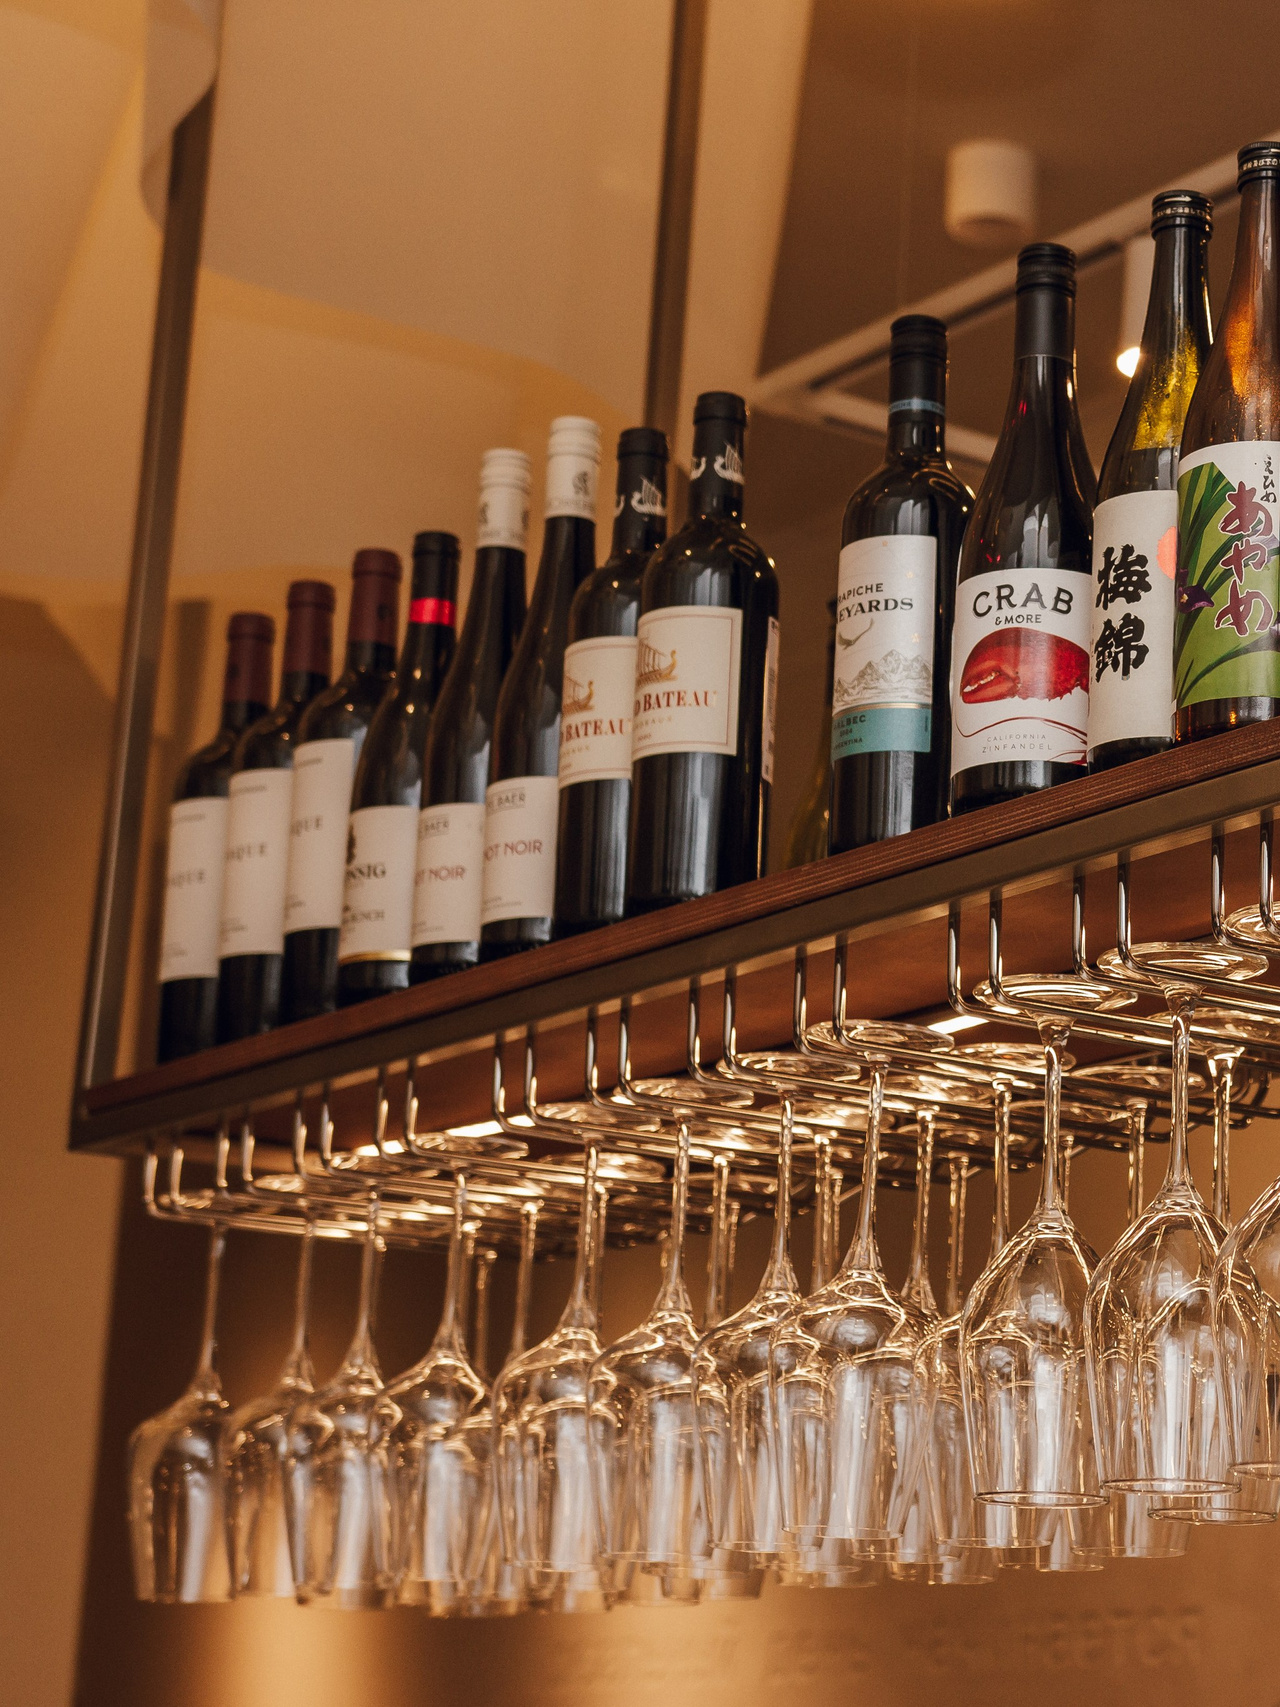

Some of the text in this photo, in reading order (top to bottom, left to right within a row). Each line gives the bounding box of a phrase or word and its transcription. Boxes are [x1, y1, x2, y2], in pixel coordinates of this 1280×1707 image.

[1214, 480, 1275, 638] あやめ
[972, 582, 1074, 618] CRAB
[994, 614, 1042, 626] & MORE
[1094, 543, 1153, 683] 梅錦
[643, 690, 716, 713] BATEAU
[565, 718, 632, 742] BATEAU
[986, 733, 1047, 743] CALIFORNIA
[982, 743, 1053, 754] ZINFANDEL
[503, 839, 543, 857] NOIR
[428, 864, 466, 881] NOIR
